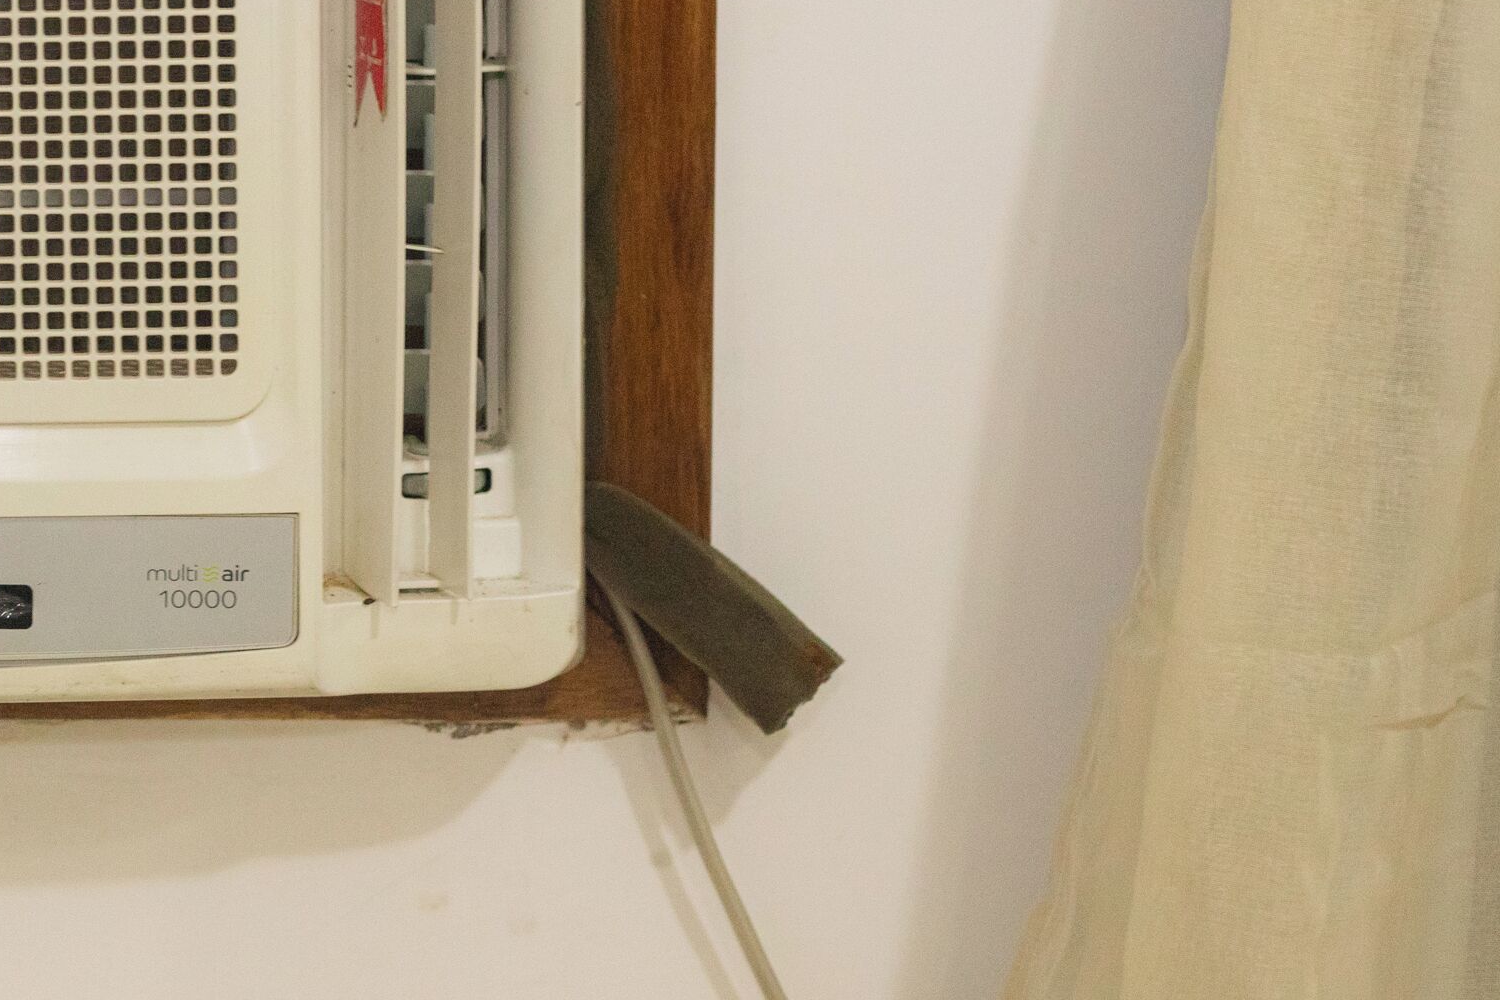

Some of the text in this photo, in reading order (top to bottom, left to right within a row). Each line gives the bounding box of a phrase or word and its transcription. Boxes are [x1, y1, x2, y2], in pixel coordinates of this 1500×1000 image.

[146, 564, 250, 582] multi air
[158, 589, 238, 609] 10000
